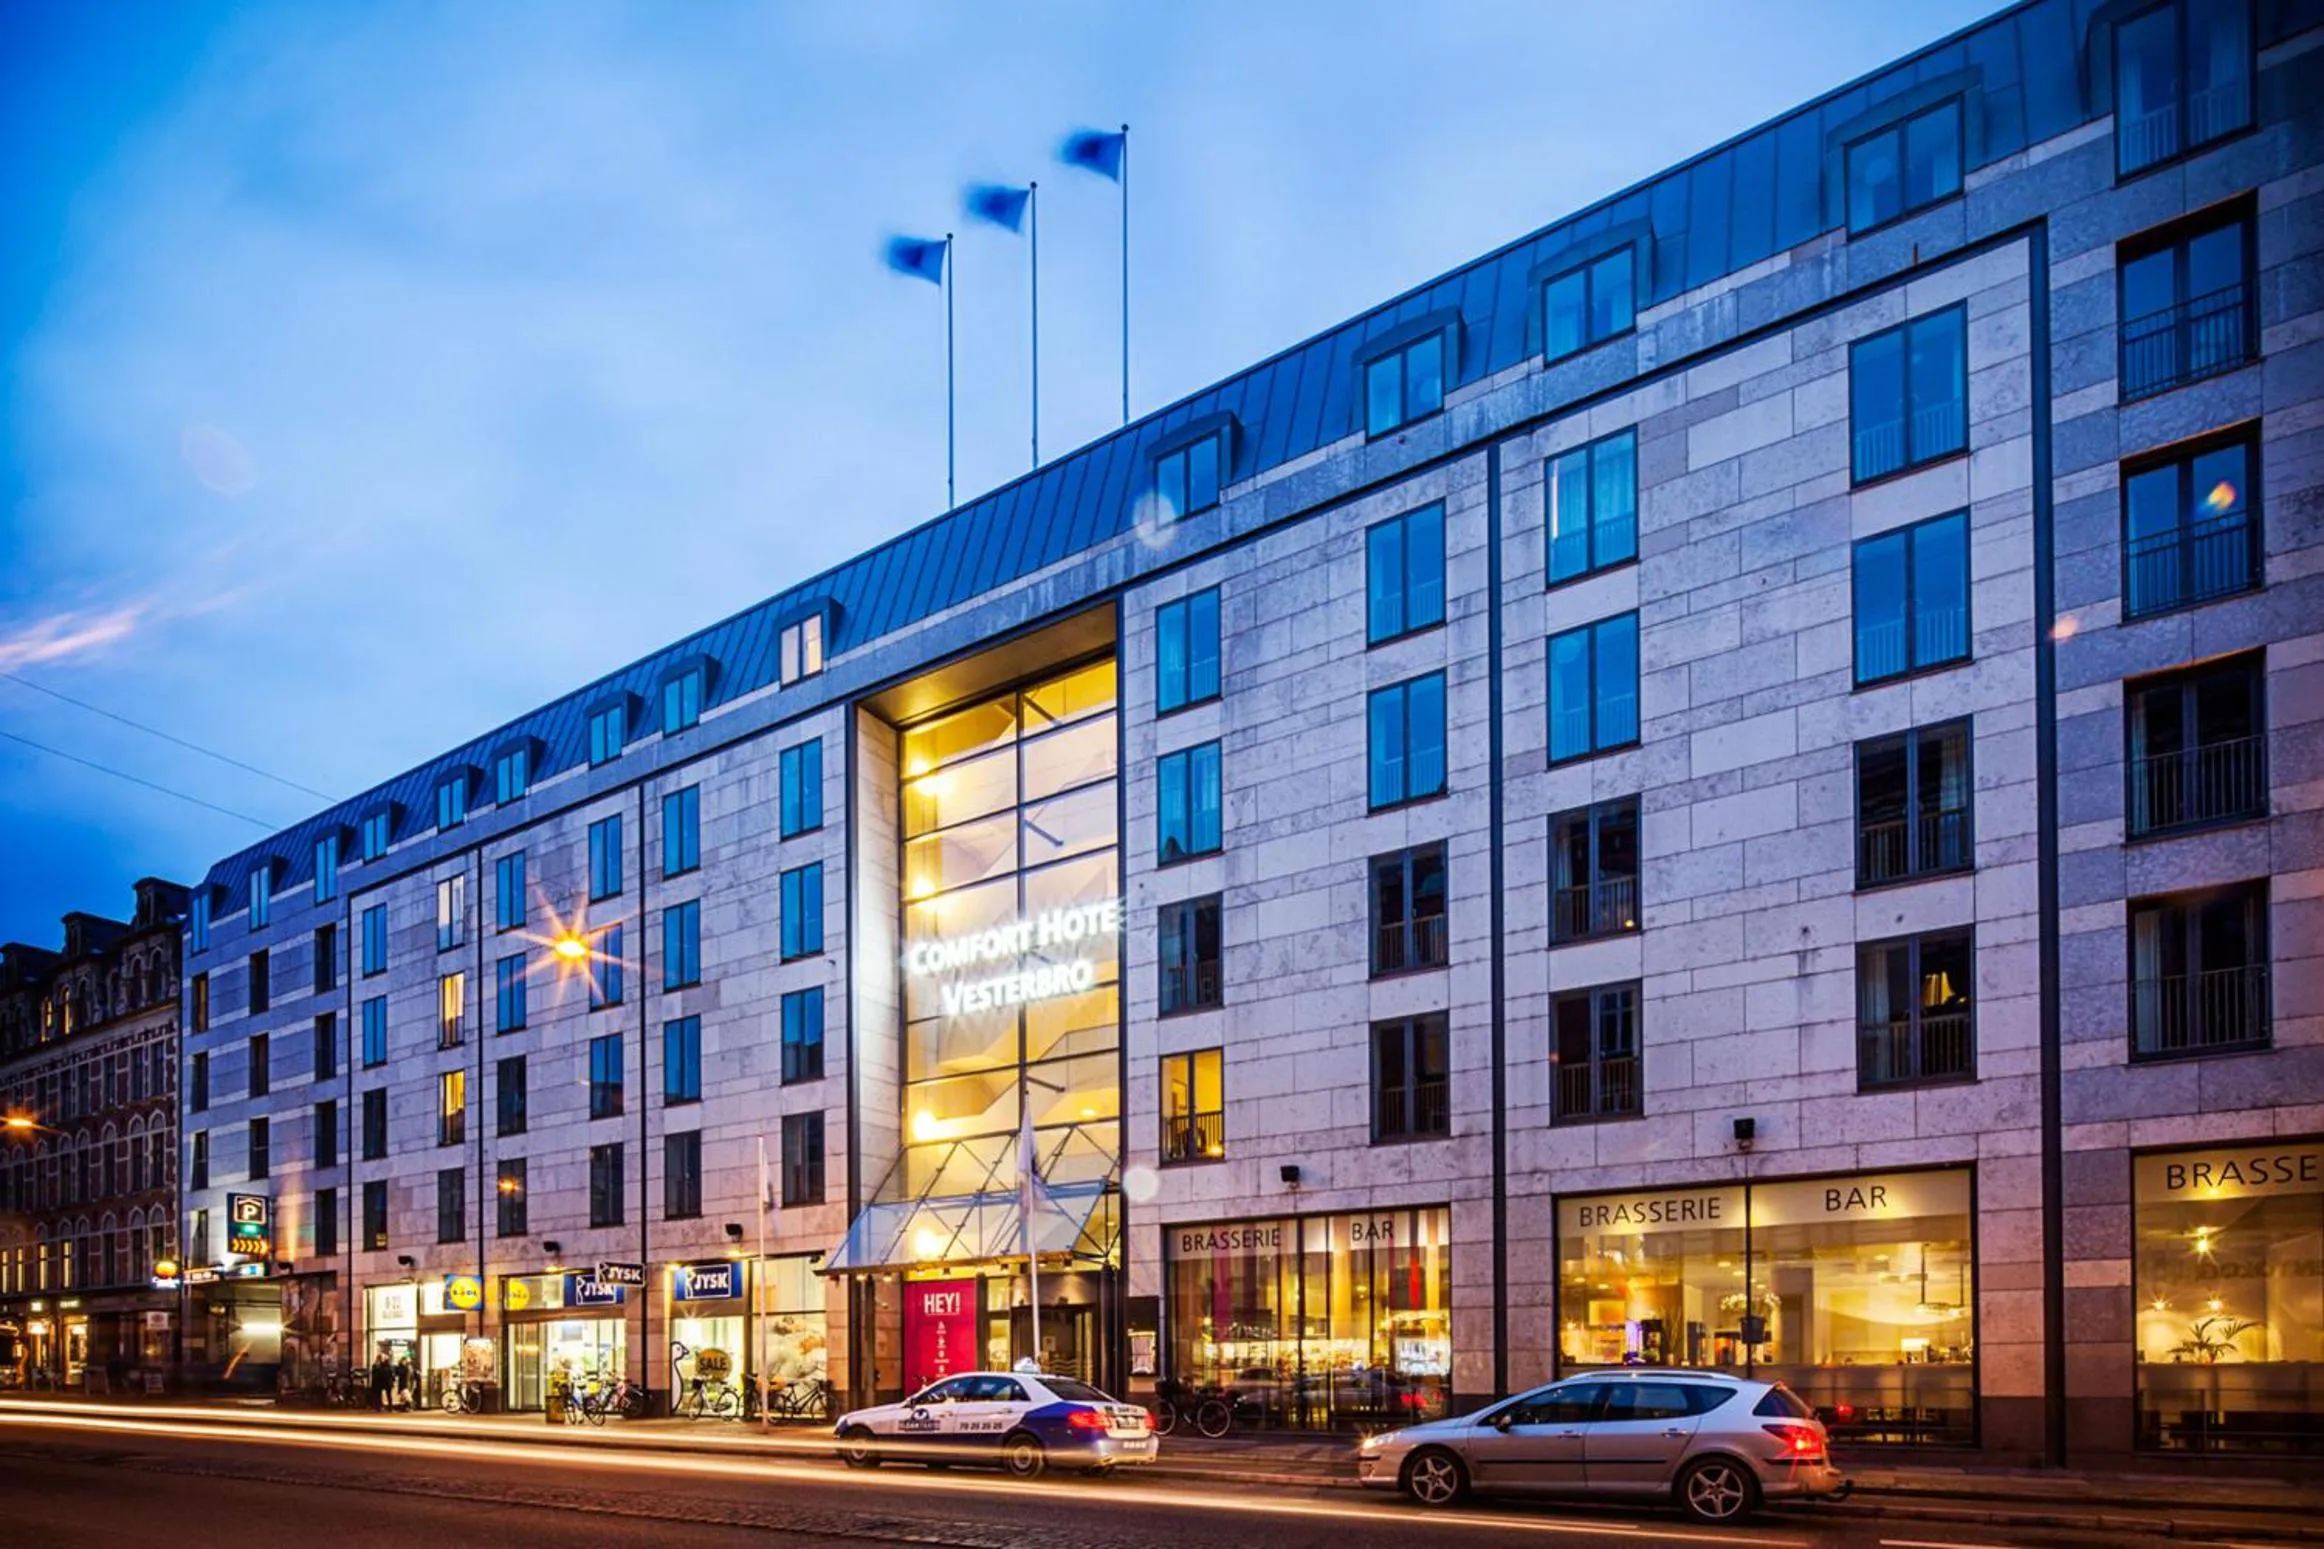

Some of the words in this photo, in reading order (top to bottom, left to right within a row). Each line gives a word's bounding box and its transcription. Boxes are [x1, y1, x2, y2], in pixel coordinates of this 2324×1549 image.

[911, 922, 1032, 975] COMFORT
[941, 959, 1094, 1015] VESTERBRO
[2167, 1154, 2319, 1190] BRASSE
[242, 1203, 258, 1221] P
[1579, 1197, 1721, 1228] BRASSERIE
[1825, 1185, 1887, 1212] BAR
[1182, 1227, 1282, 1253] BRASSERIE
[1351, 1220, 1394, 1242] BAR
[607, 1266, 641, 1281] JYSK
[694, 1272, 729, 1290] JYSK
[584, 1280, 614, 1296] JYSK
[924, 1292, 960, 1314] HEY!
[699, 1357, 728, 1371] SALE
